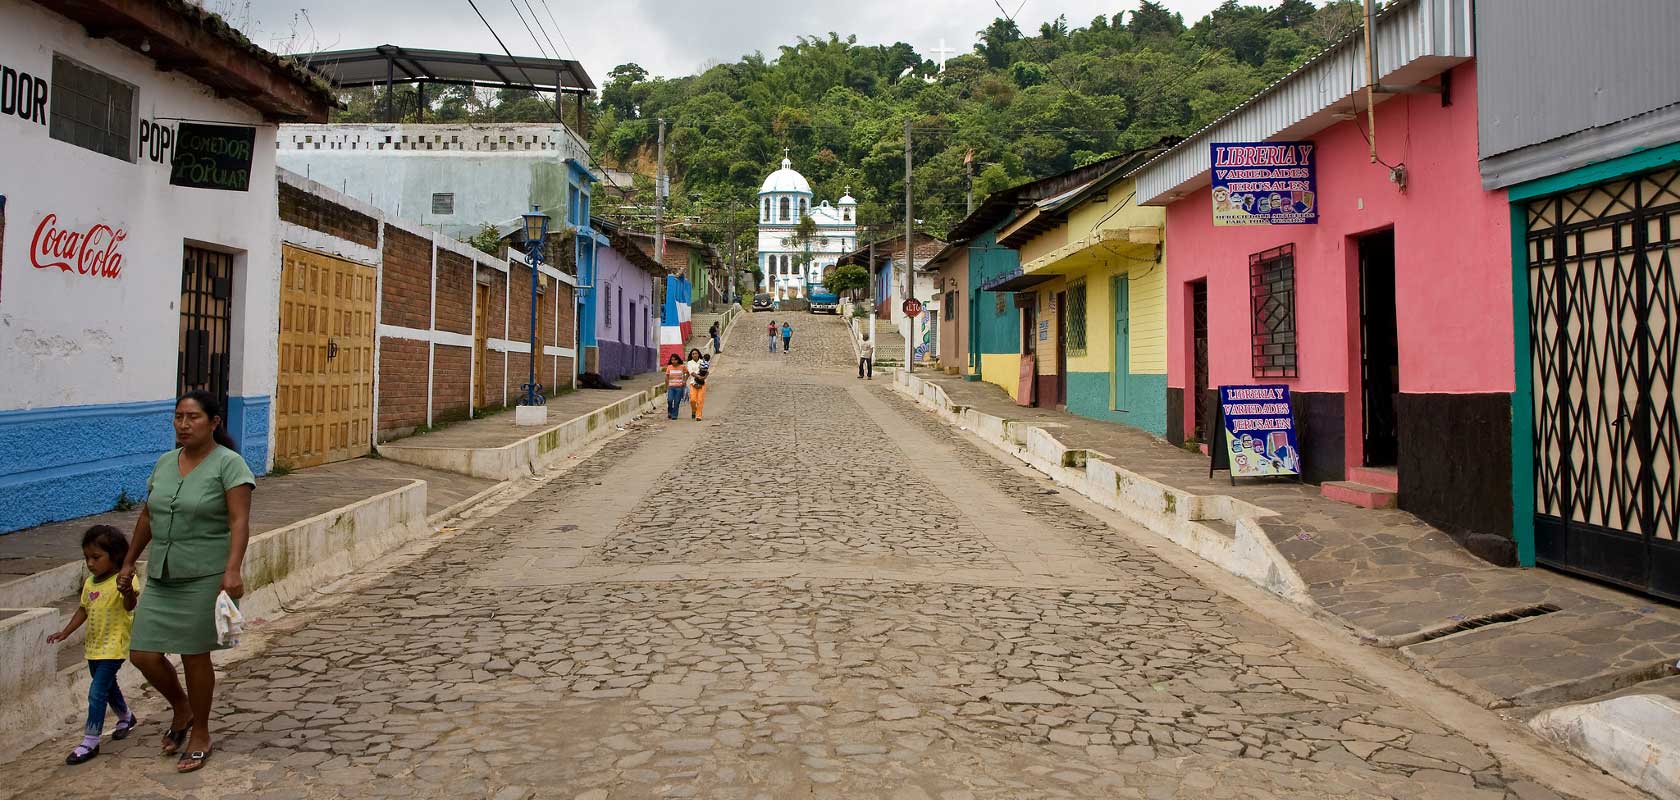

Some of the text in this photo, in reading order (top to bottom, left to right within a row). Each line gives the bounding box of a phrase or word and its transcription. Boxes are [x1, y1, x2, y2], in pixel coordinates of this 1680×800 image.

[0, 64, 48, 126] DOR
[1216, 145, 1313, 167] LIBRERIA Y
[176, 153, 248, 188] POPULAR
[1216, 168, 1309, 179] VARIEDADES
[1227, 181, 1309, 193] JERUSALEN
[30, 213, 127, 279] Coca-Cola
[1227, 388, 1284, 400] LIBRERIA Y
[1223, 403, 1289, 415] VARIEDADES
[1233, 418, 1291, 433] JERUSALEN
